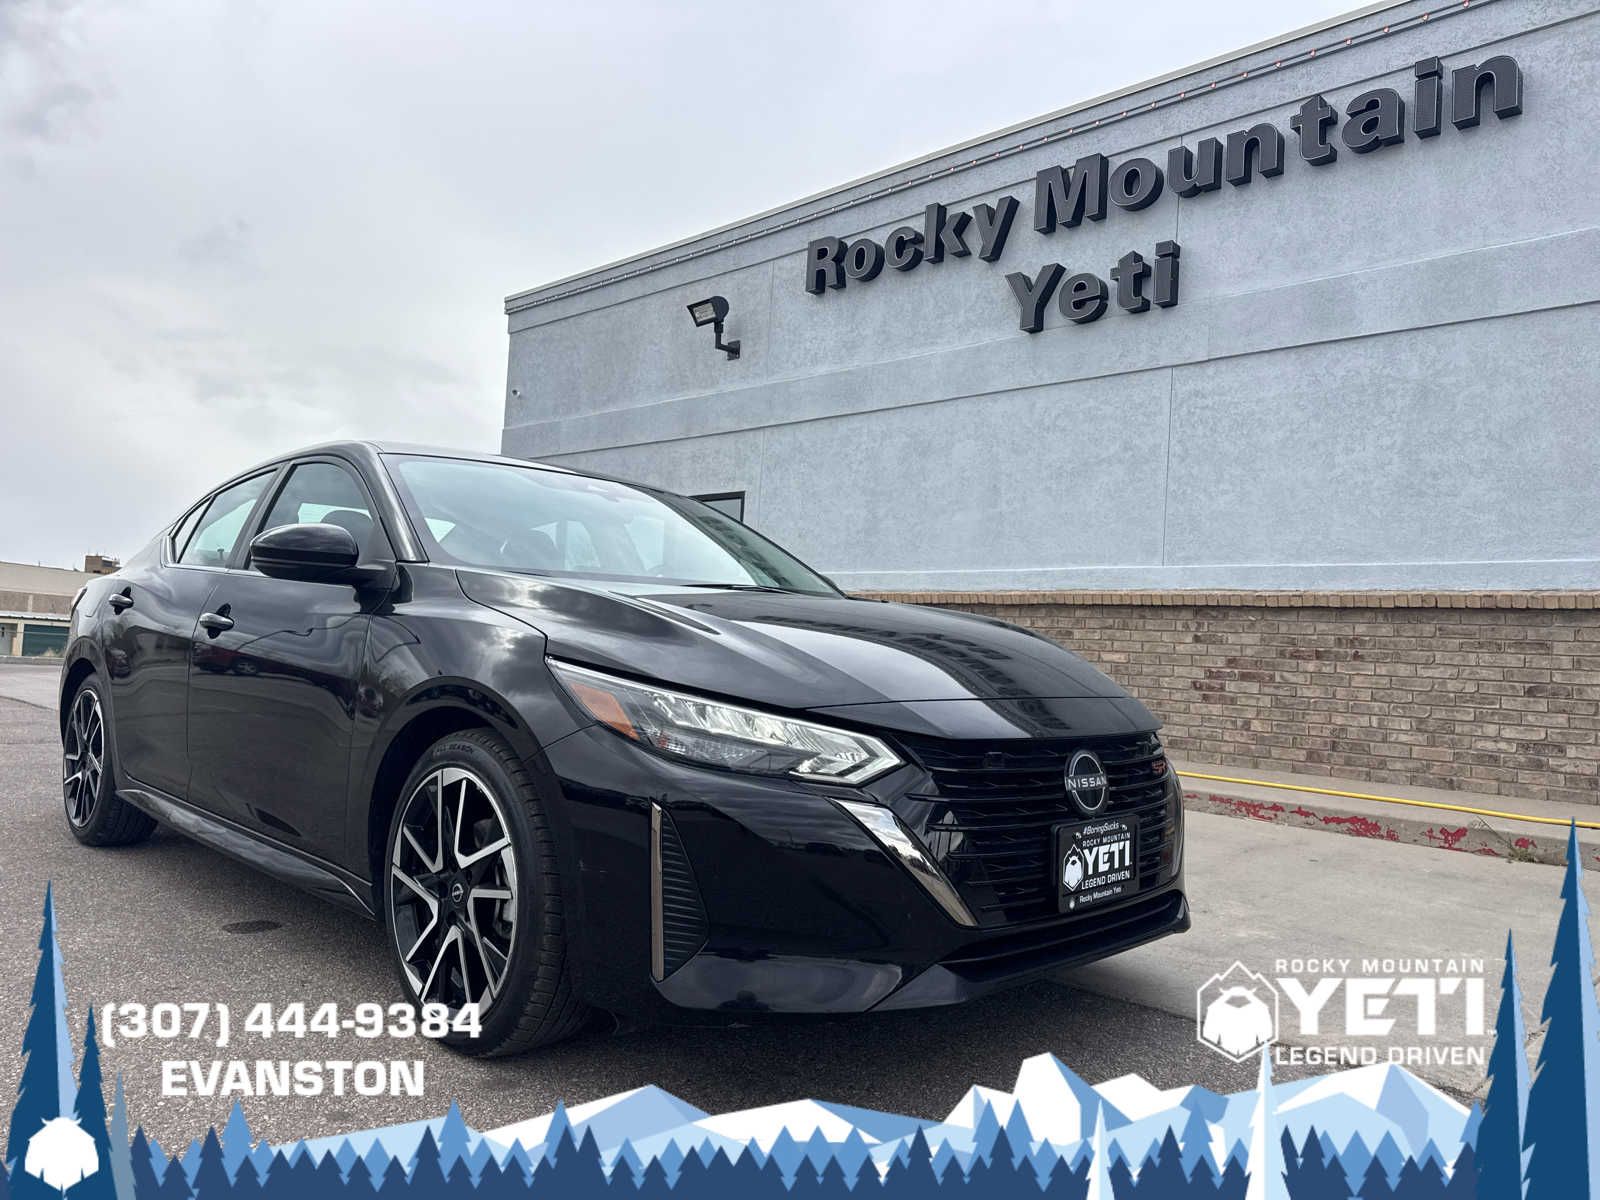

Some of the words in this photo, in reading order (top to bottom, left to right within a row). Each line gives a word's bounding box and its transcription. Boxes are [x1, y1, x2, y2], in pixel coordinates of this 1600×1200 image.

[805, 194, 1020, 295] Rocky
[1033, 53, 1524, 235] Mountain
[1005, 239, 1181, 333] Yeti
[1066, 776, 1107, 790] NISSAN
[1082, 838, 1101, 848] ROCKY
[1102, 831, 1131, 845] MOUNTAIN
[1082, 840, 1131, 875] YETI
[1081, 876, 1106, 890] LEGEND
[1107, 870, 1130, 884] DRIVEN
